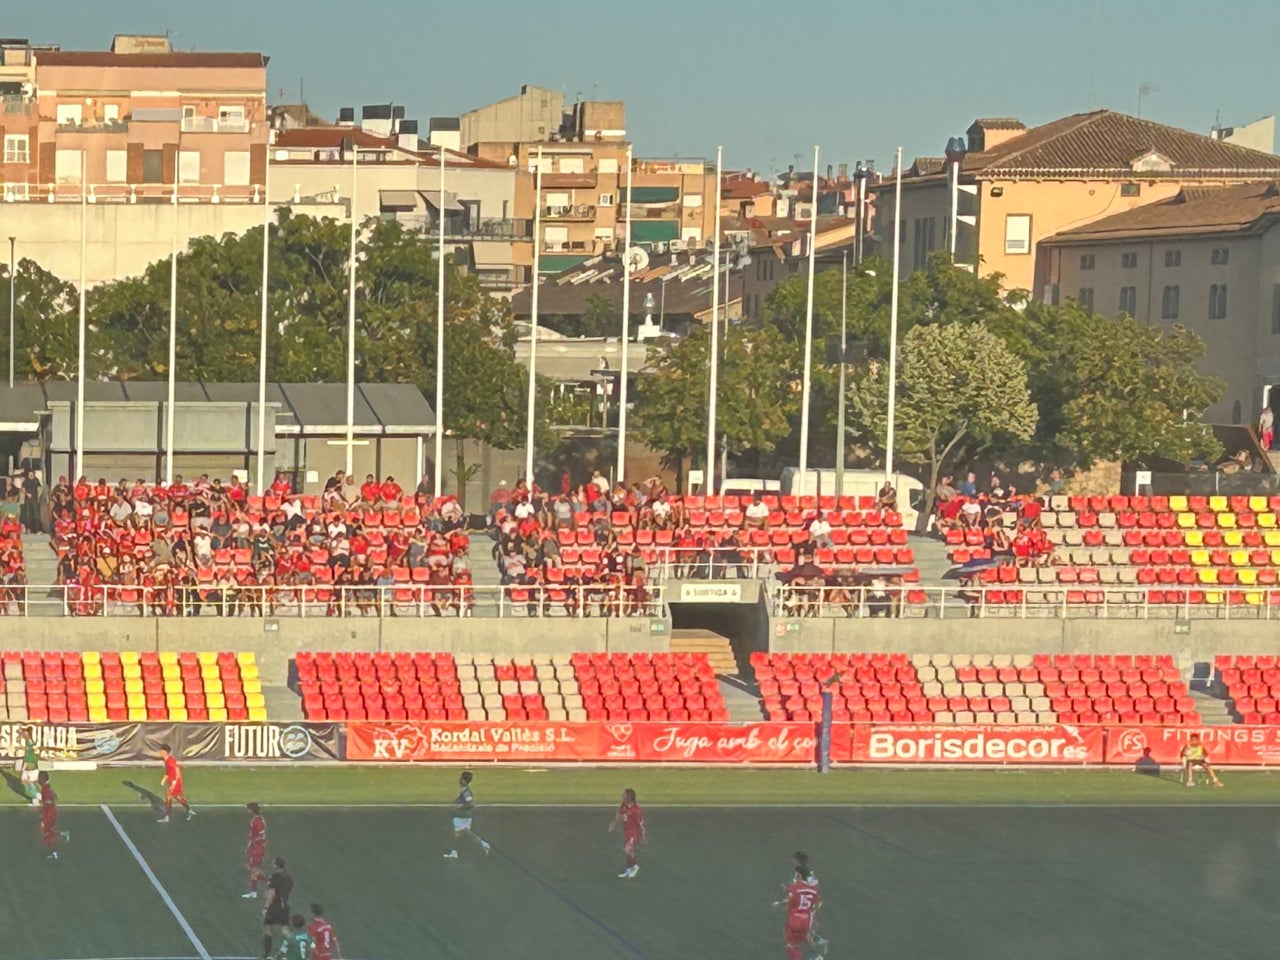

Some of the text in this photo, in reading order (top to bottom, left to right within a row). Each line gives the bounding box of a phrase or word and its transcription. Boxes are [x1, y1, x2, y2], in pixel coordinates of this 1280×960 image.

[430, 728, 486, 742] Kordal
[490, 728, 540, 742] Vallès
[717, 728, 762, 750] amb
[1124, 735, 1142, 750] FS
[1163, 728, 1265, 742] FITTINGS
[373, 740, 408, 758] KV
